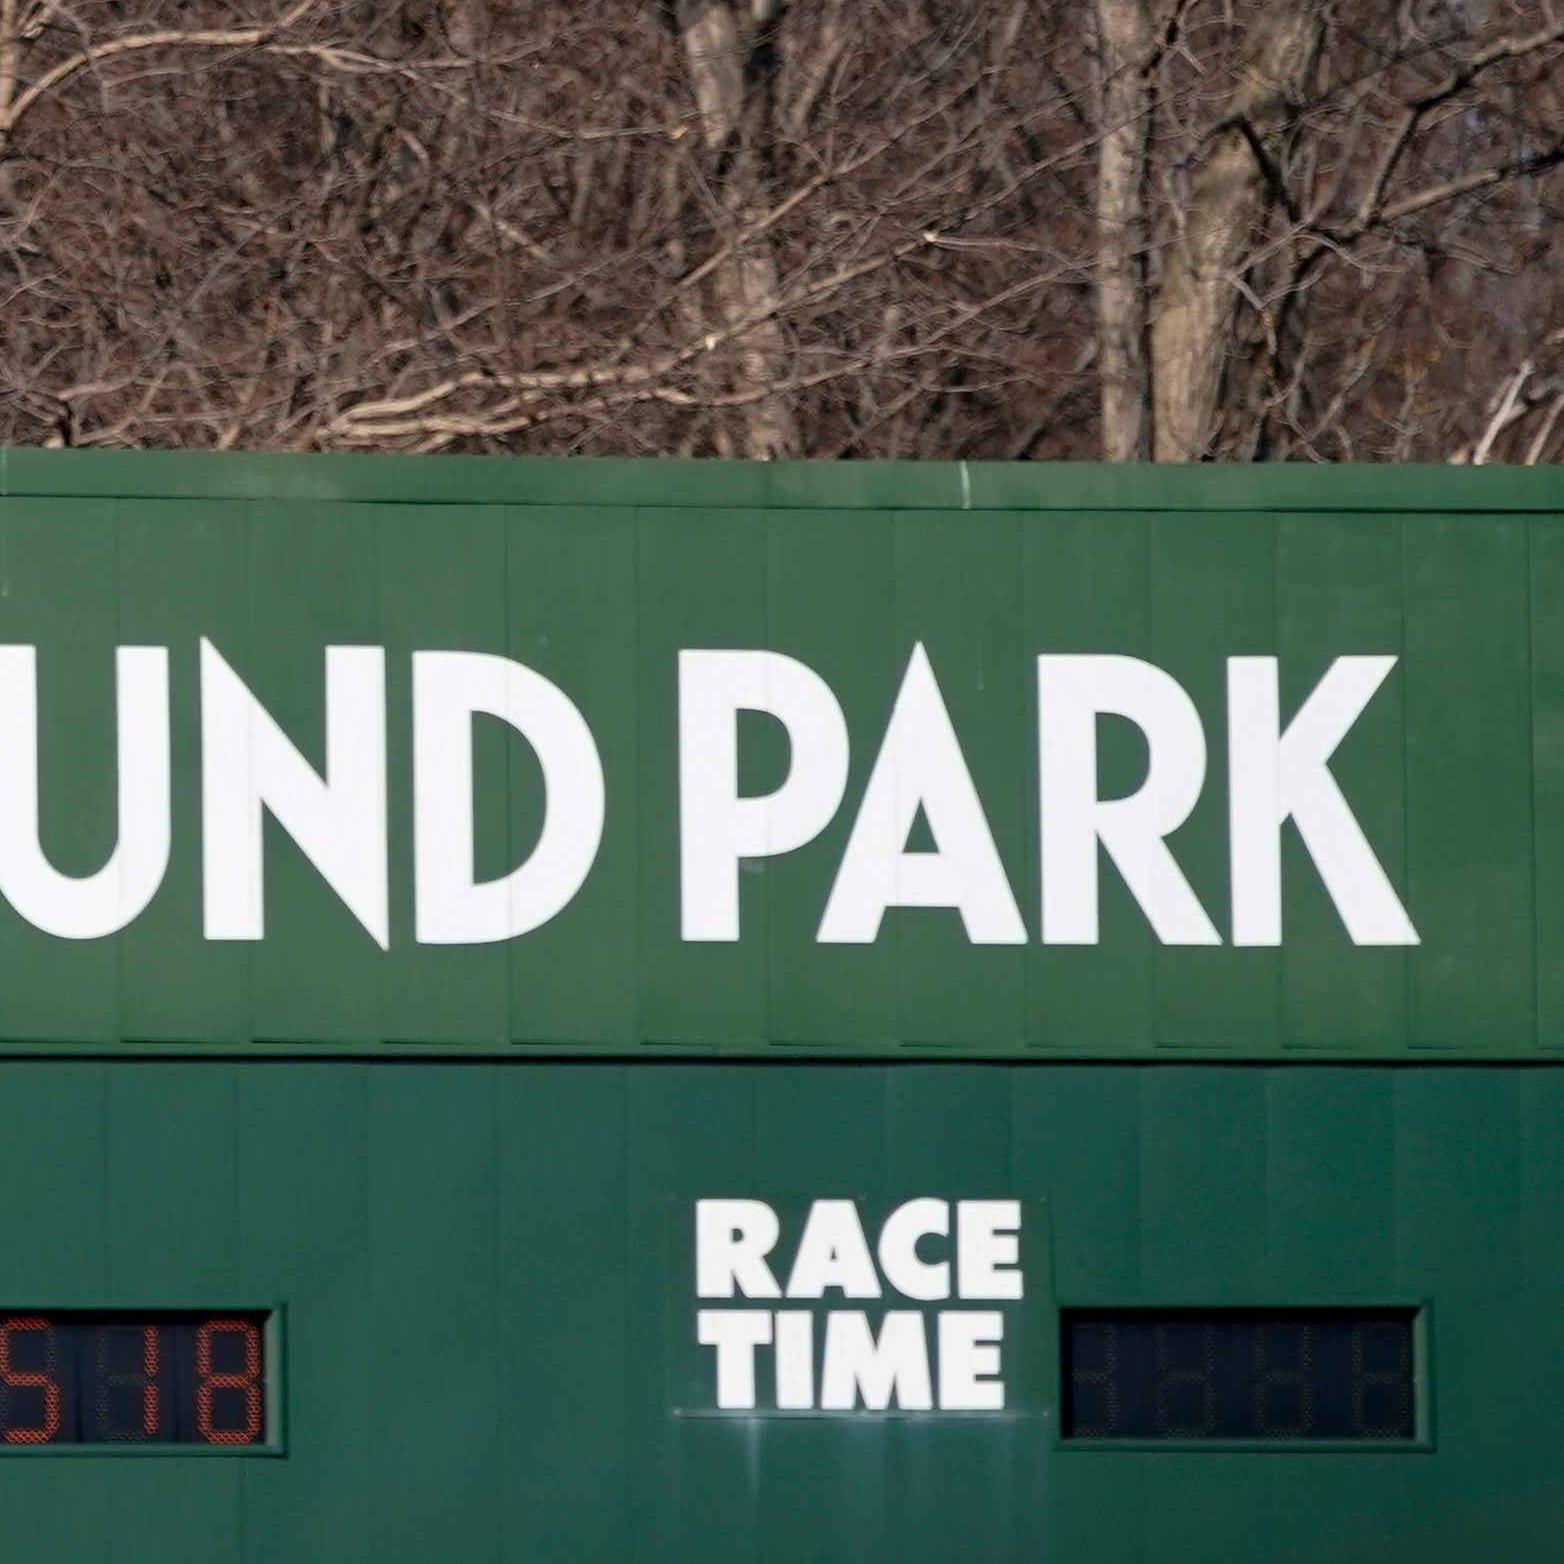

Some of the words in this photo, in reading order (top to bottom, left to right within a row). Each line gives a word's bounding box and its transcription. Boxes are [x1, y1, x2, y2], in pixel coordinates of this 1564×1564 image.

[678, 642, 1421, 947] PARK
[696, 1197, 1024, 1301] RACE
[697, 1309, 1005, 1411] TIME
